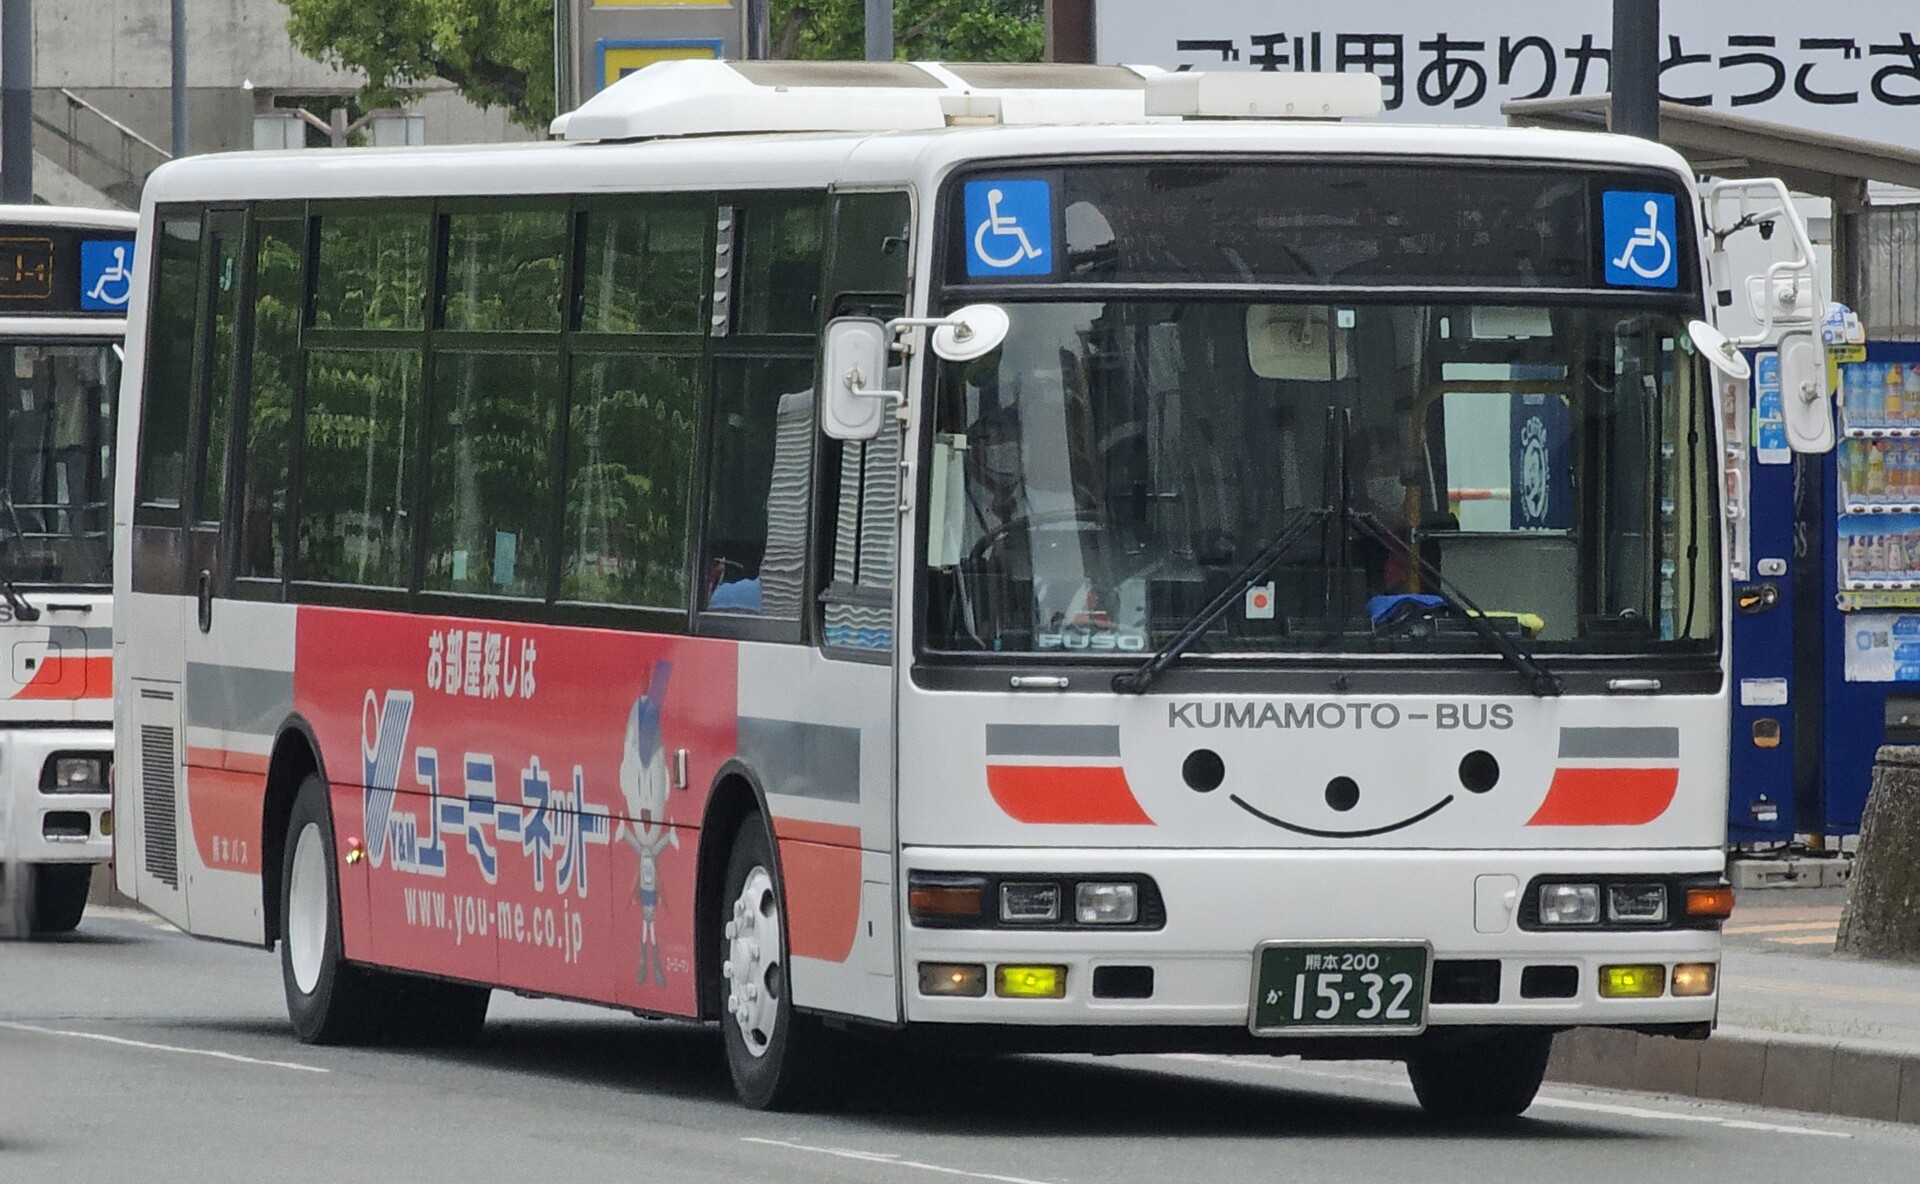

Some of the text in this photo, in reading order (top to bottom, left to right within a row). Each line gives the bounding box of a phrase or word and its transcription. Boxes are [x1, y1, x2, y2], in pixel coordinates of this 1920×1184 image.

[427, 628, 537, 700] お部屋探しは
[1038, 633, 1145, 651] FUSO
[416, 746, 610, 898] ユーミーネット
[404, 887, 583, 964] www.you-me.co.jp
[1265, 973, 1413, 1020] か 15-32
